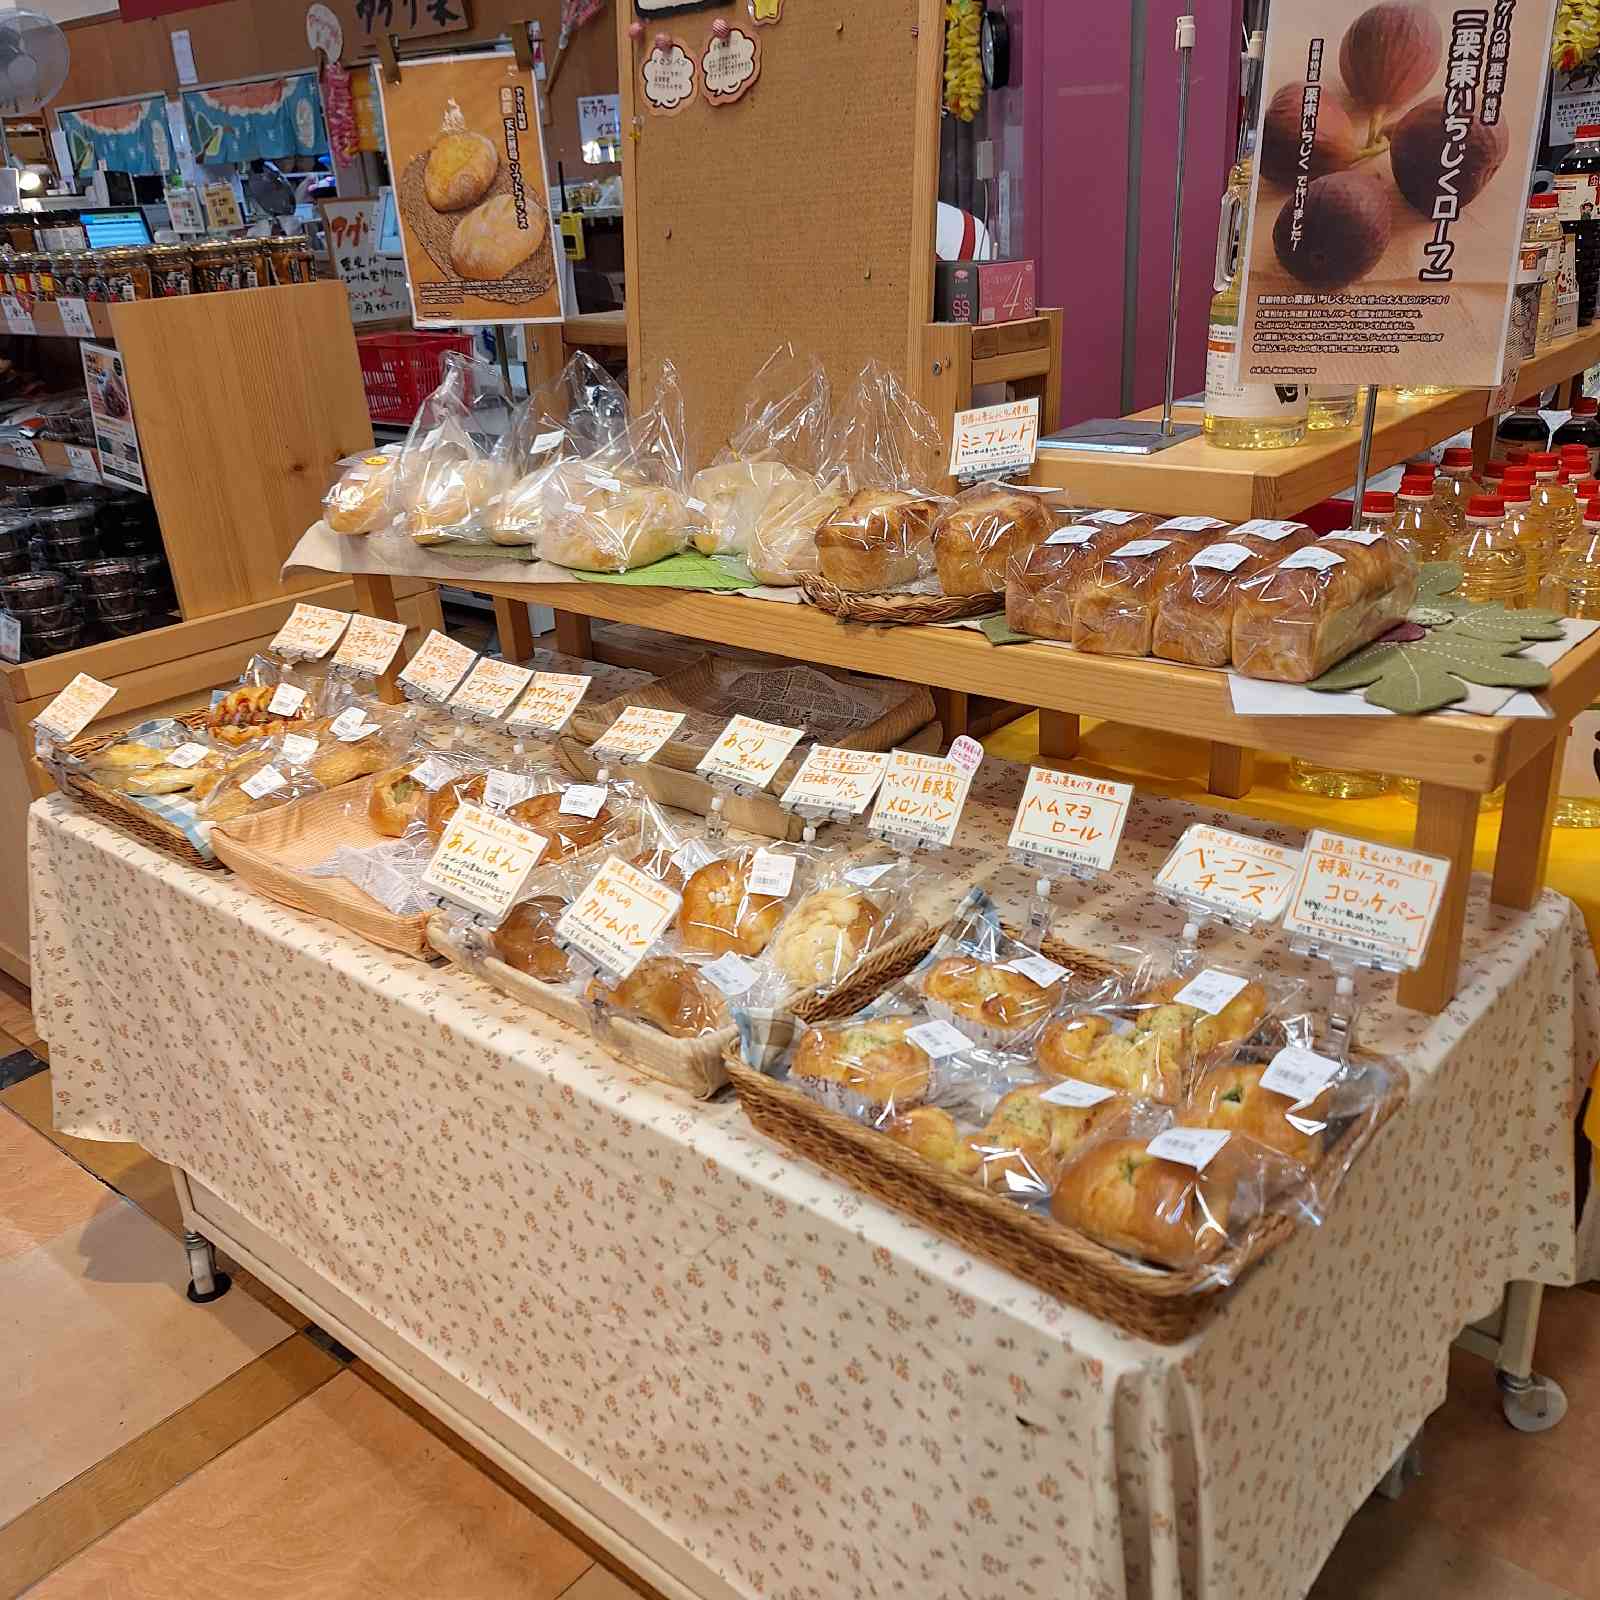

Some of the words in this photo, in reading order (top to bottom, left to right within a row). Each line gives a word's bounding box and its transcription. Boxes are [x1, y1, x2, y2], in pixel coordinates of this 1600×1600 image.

[953, 300, 970, 317] SS
[886, 796, 952, 821] メロンパン
[1027, 795, 1093, 820] ハムマヨ
[1052, 820, 1104, 842] ロール
[1183, 847, 1277, 881] ベーコン
[1317, 857, 1400, 890] 特製ソースの
[1194, 873, 1280, 904] チーズ
[1325, 883, 1426, 921] コロッケパン
[582, 898, 649, 946] クリームパン
